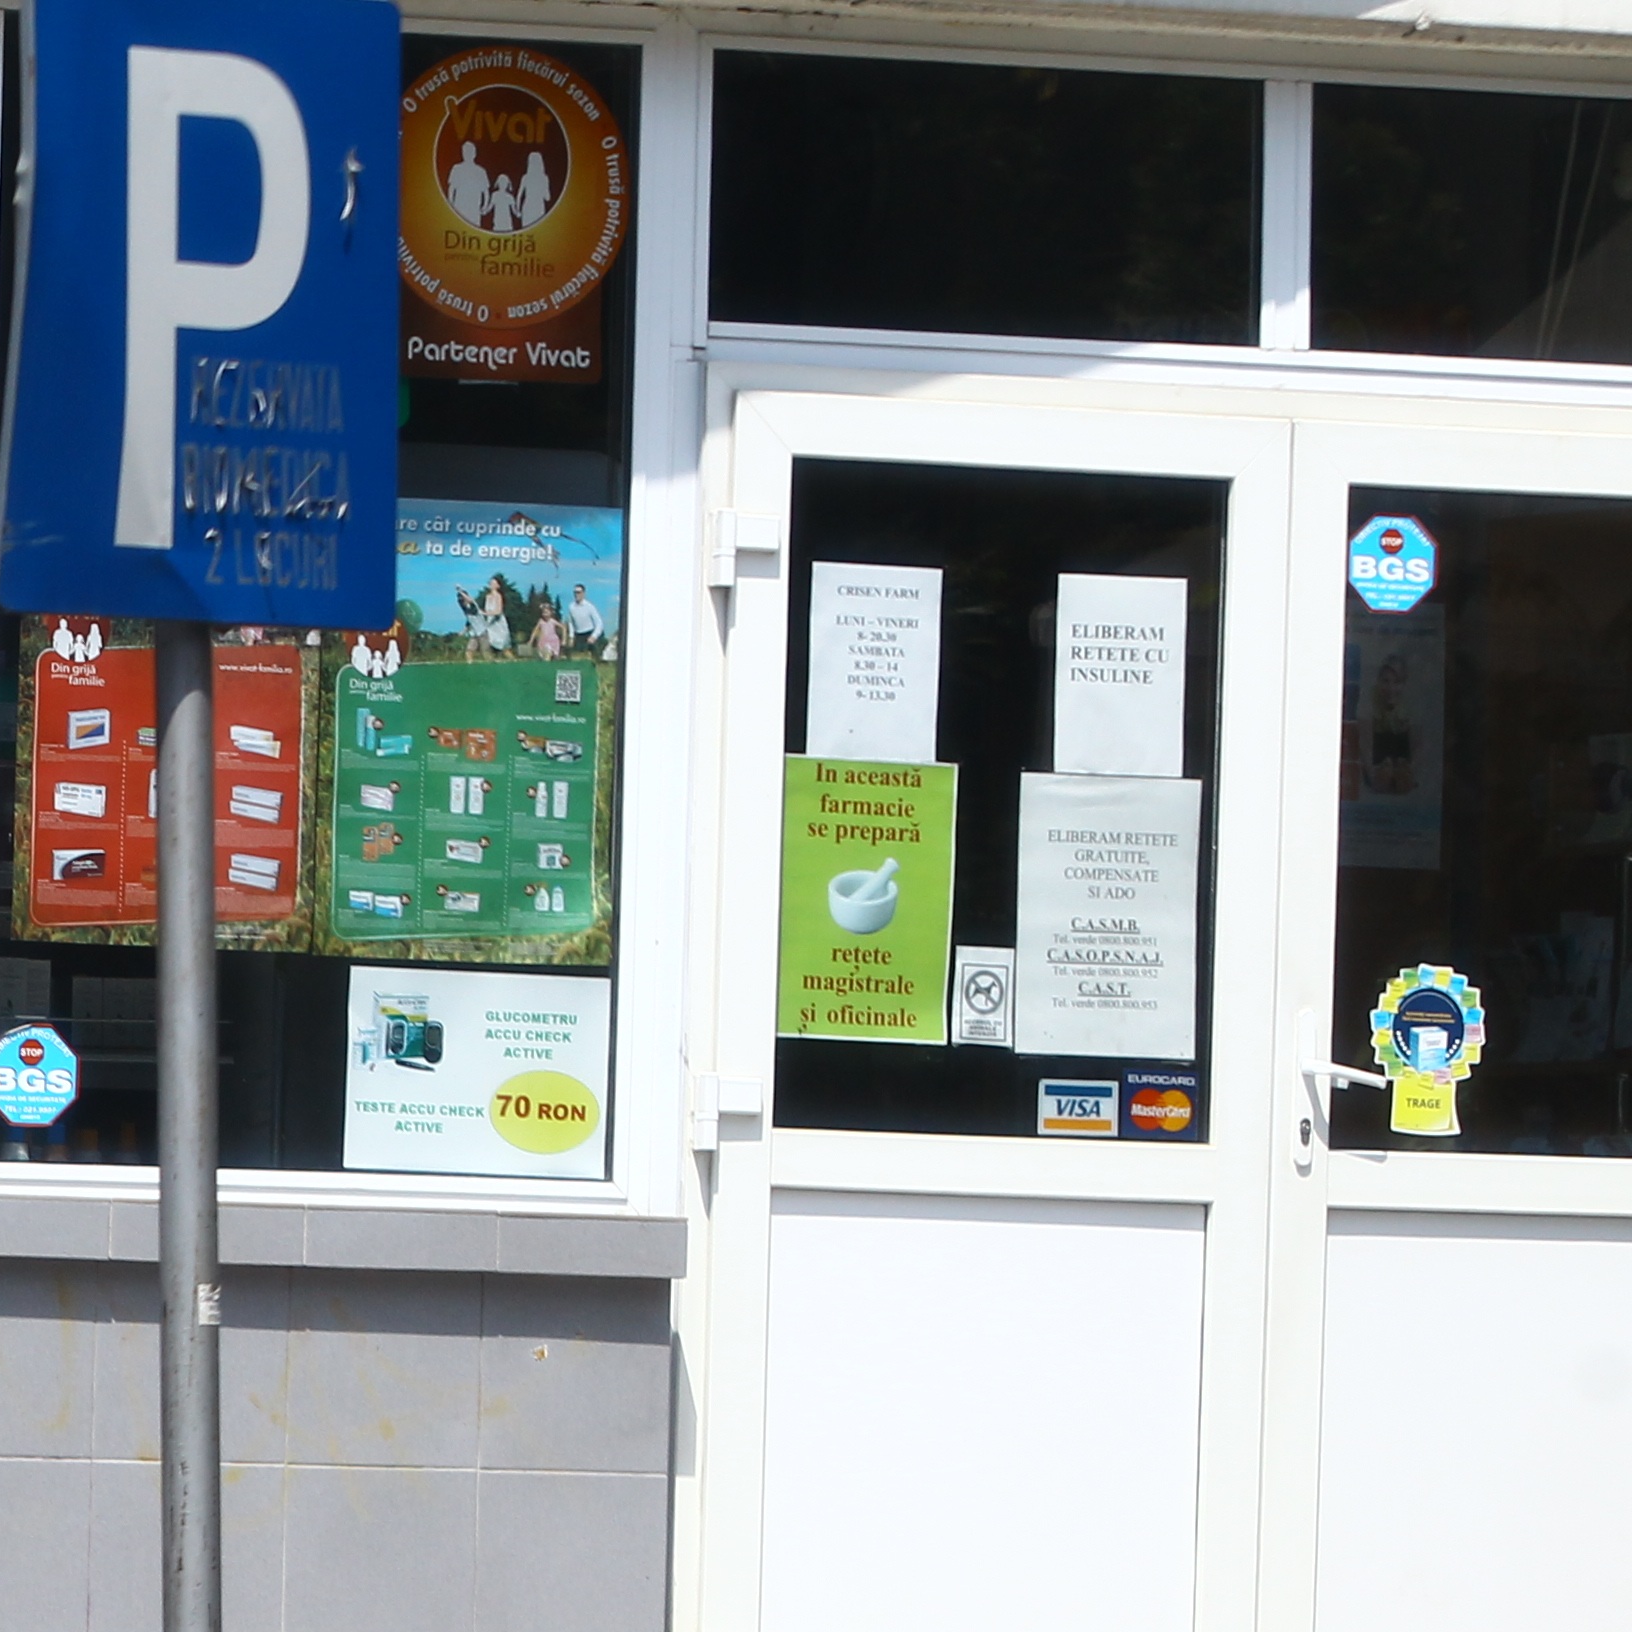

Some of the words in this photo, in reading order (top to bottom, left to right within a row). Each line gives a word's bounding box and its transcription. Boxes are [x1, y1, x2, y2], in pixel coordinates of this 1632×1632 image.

[415, 64, 450, 100] trusă
[451, 51, 513, 82] potrivită
[516, 50, 570, 87] fiecărui
[565, 82, 600, 122] sezon
[447, 99, 553, 144] Vivat
[604, 152, 627, 196] trusă
[590, 196, 622, 263] potrivită
[444, 230, 482, 251] Din
[487, 233, 537, 259] grijă
[480, 254, 556, 279] familie
[114, 45, 311, 549] P
[507, 296, 549, 319] sezon
[406, 336, 519, 371] Partener
[524, 341, 591, 369] Vivat
[456, 518, 537, 538] cuprinde
[541, 524, 562, 537] cu
[1380, 537, 1404, 547] STOP
[204, 526, 225, 586] 2
[425, 541, 443, 555] ta
[449, 540, 473, 557] de
[478, 543, 554, 564] energie!
[1352, 555, 1430, 584] BGS
[836, 584, 882, 599] CRISEN
[884, 587, 921, 601] FARM
[835, 614, 866, 628] LUNI
[876, 617, 921, 630] VINERI
[1070, 623, 1166, 642] ELIBERAM
[848, 644, 906, 659] SAMBATA
[1070, 646, 1141, 664] RETETE
[1144, 648, 1171, 664] CU
[51, 662, 70, 674] Din
[1070, 667, 1154, 686] INSULINE
[68, 675, 106, 687] familie
[815, 763, 838, 784] In
[844, 763, 923, 789] această
[820, 794, 915, 818] farmacie
[807, 821, 829, 838] se
[835, 822, 921, 847] prepară
[1047, 829, 1122, 846] ELIBERAM
[1124, 832, 1179, 848] RETETE
[1073, 849, 1150, 866] GRATUITE,
[1063, 867, 1160, 884] COMPENSATE
[1087, 886, 1102, 899] SI
[1104, 887, 1137, 901] ADO
[1073, 935, 1096, 946] verde
[1072, 966, 1096, 977] verde
[802, 972, 915, 997] magistrale
[1072, 998, 1095, 1010] verde
[485, 1010, 578, 1026] GLUCOMETRU
[826, 1005, 917, 1028] oficinale
[484, 1029, 521, 1042] ACCU
[524, 1030, 572, 1043] CHECK
[19, 1047, 44, 1058] STOP
[502, 1048, 554, 1060] ACTIVE
[1127, 1073, 1196, 1087] EUROCARD
[354, 1100, 396, 1114] TESTE
[399, 1102, 435, 1116] ACCU
[439, 1105, 485, 1118] CHECK
[496, 1094, 531, 1119] 70
[537, 1103, 587, 1122] RON
[1055, 1098, 1101, 1118] VISA
[1130, 1102, 1192, 1120] MasterCard
[1405, 1097, 1442, 1109] TRAGE
[394, 1121, 444, 1133] ACTIVE
